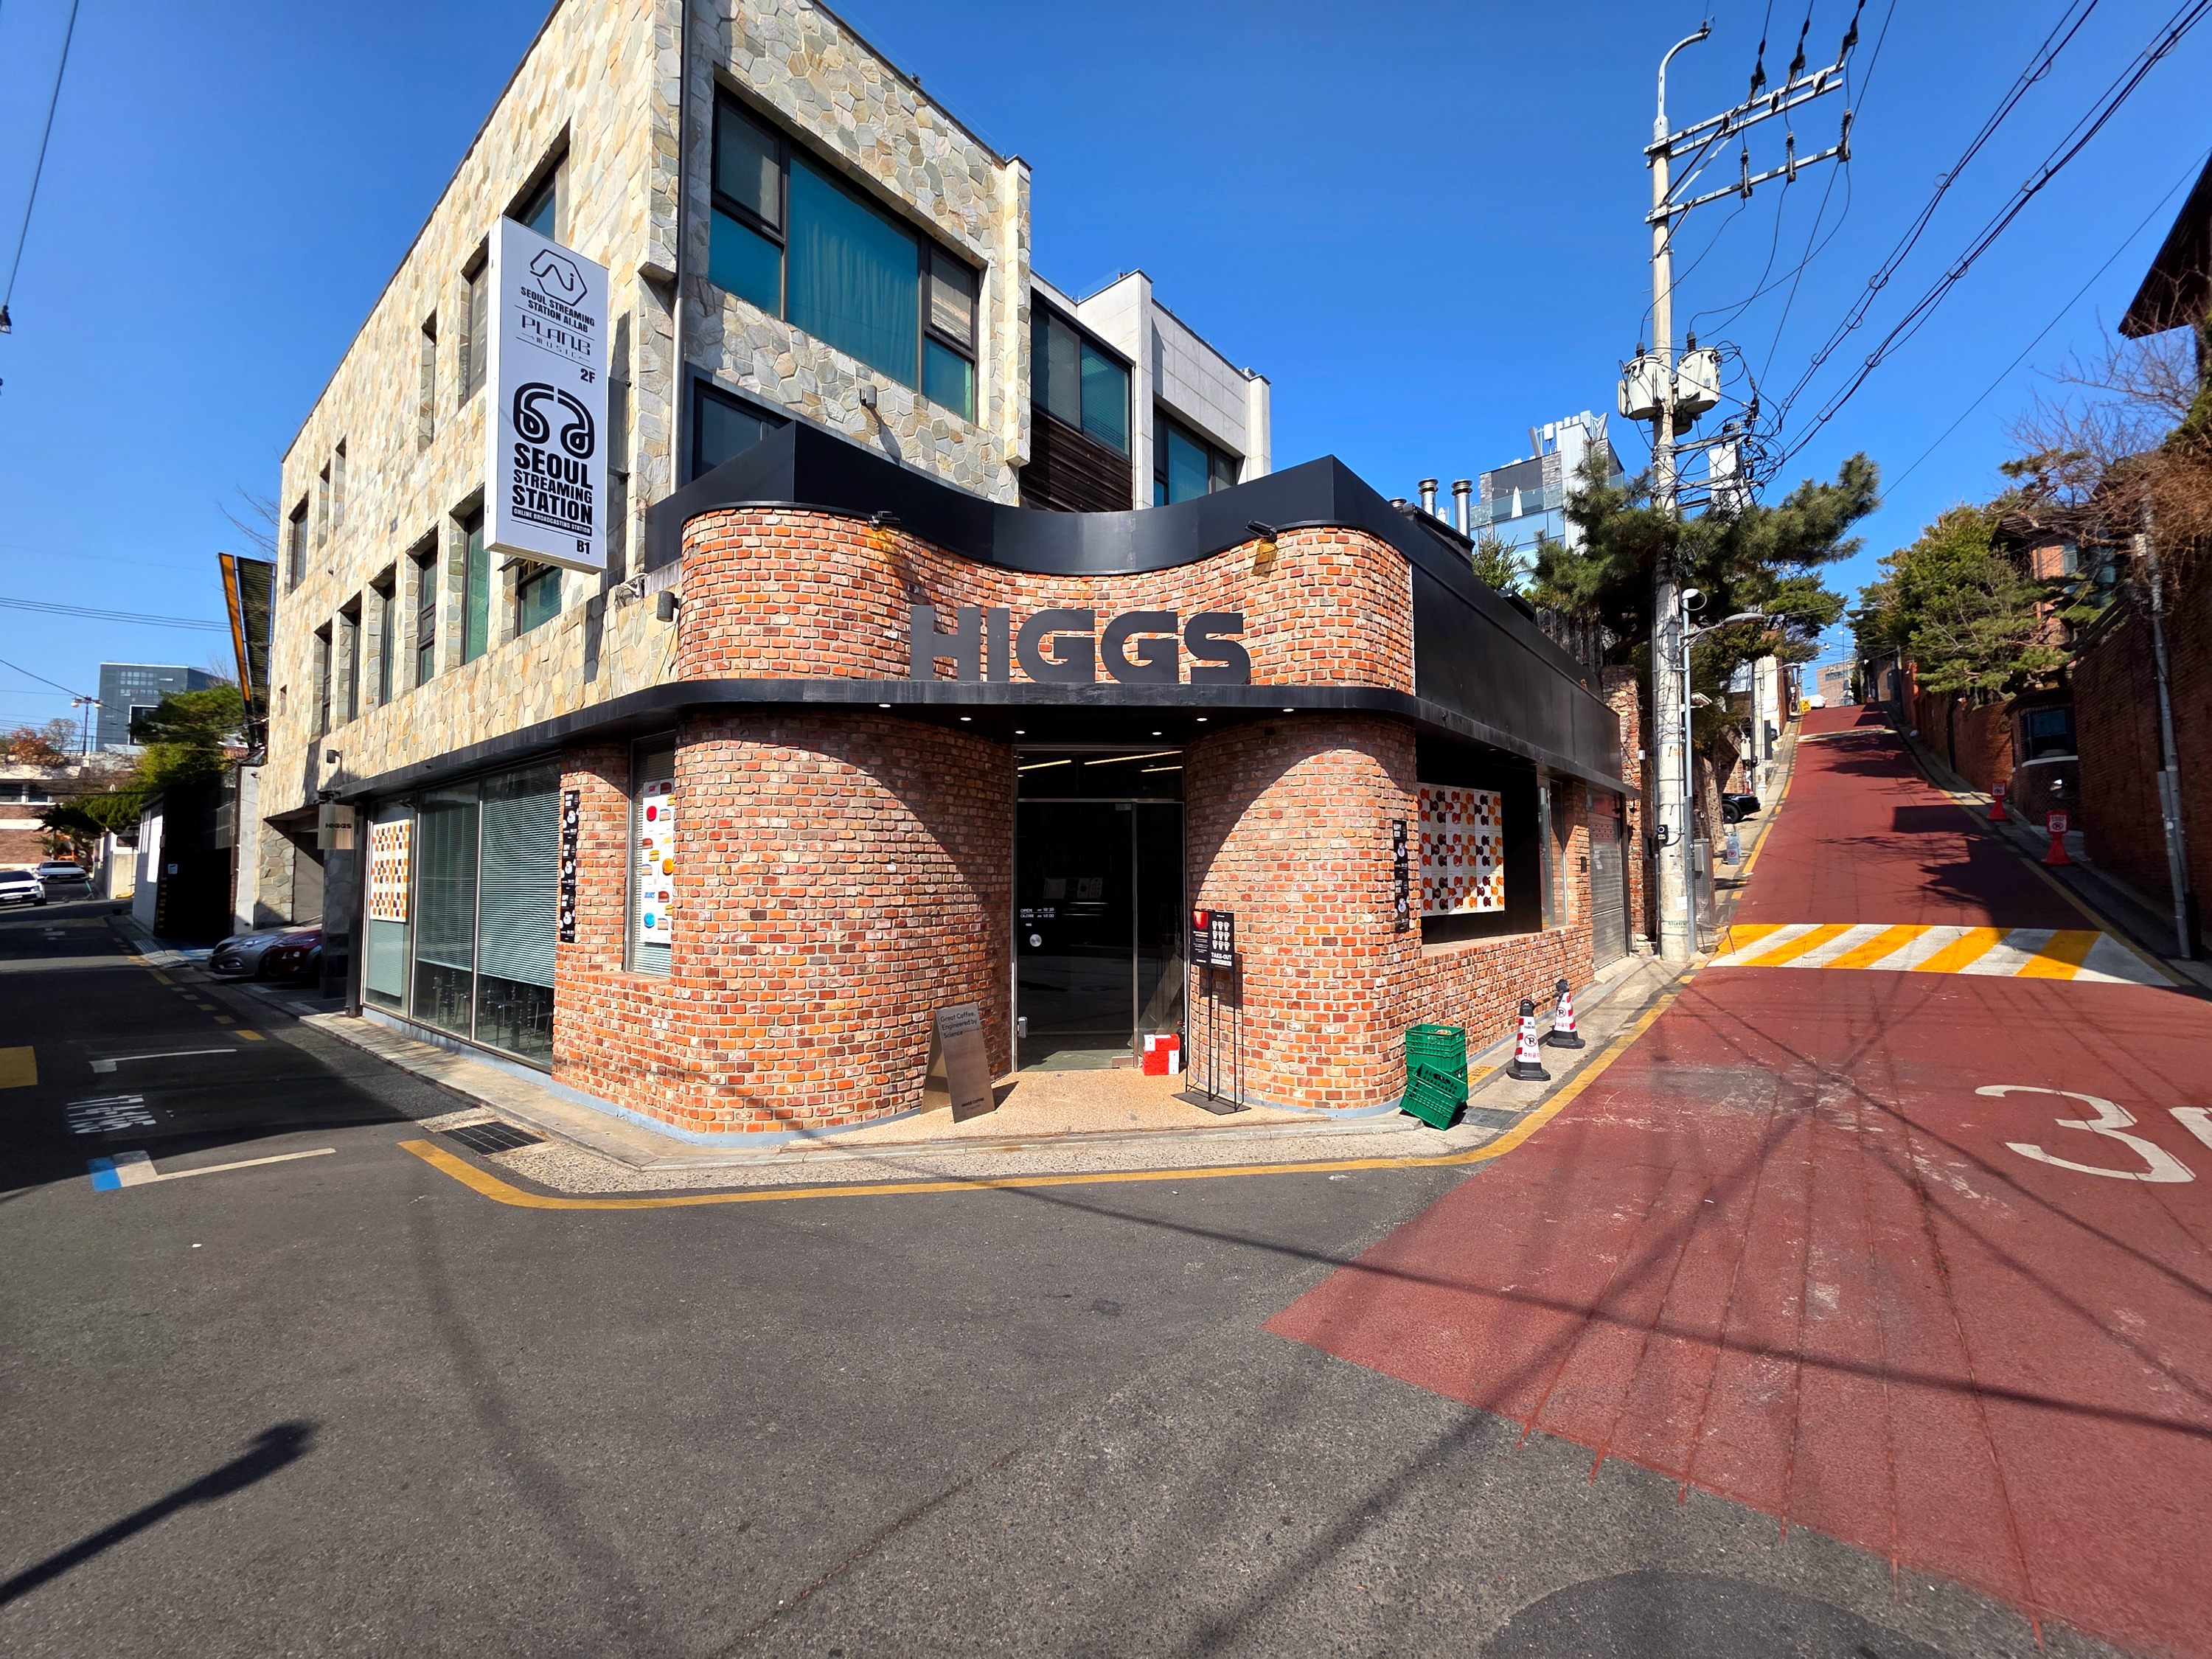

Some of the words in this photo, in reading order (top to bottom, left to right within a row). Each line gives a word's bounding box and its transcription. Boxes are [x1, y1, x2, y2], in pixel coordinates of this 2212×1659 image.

[521, 286, 547, 305] SEOUL
[549, 299, 595, 327] STREAMING
[528, 299, 561, 321] STATION
[563, 316, 588, 333] AI.LAB
[580, 368, 596, 383] 2F
[514, 442, 593, 490] SEOUL
[513, 469, 592, 504] STREAMING
[512, 484, 593, 525] STATION
[514, 508, 532, 519] ONLINE
[533, 513, 571, 529] BROADCASTING
[571, 524, 591, 534] STATION
[577, 539, 591, 554] B1
[910, 605, 1251, 684] HIGGS
[1211, 952, 1232, 960] TAKE-OUT
[940, 1014, 956, 1022] Great
[956, 1011, 975, 1019] Coffee,
[942, 1019, 970, 1030] Engineered
[944, 1031, 963, 1039] Science
[66, 1094, 156, 1133] 174-195
[1975, 1085, 2212, 1183] 3
